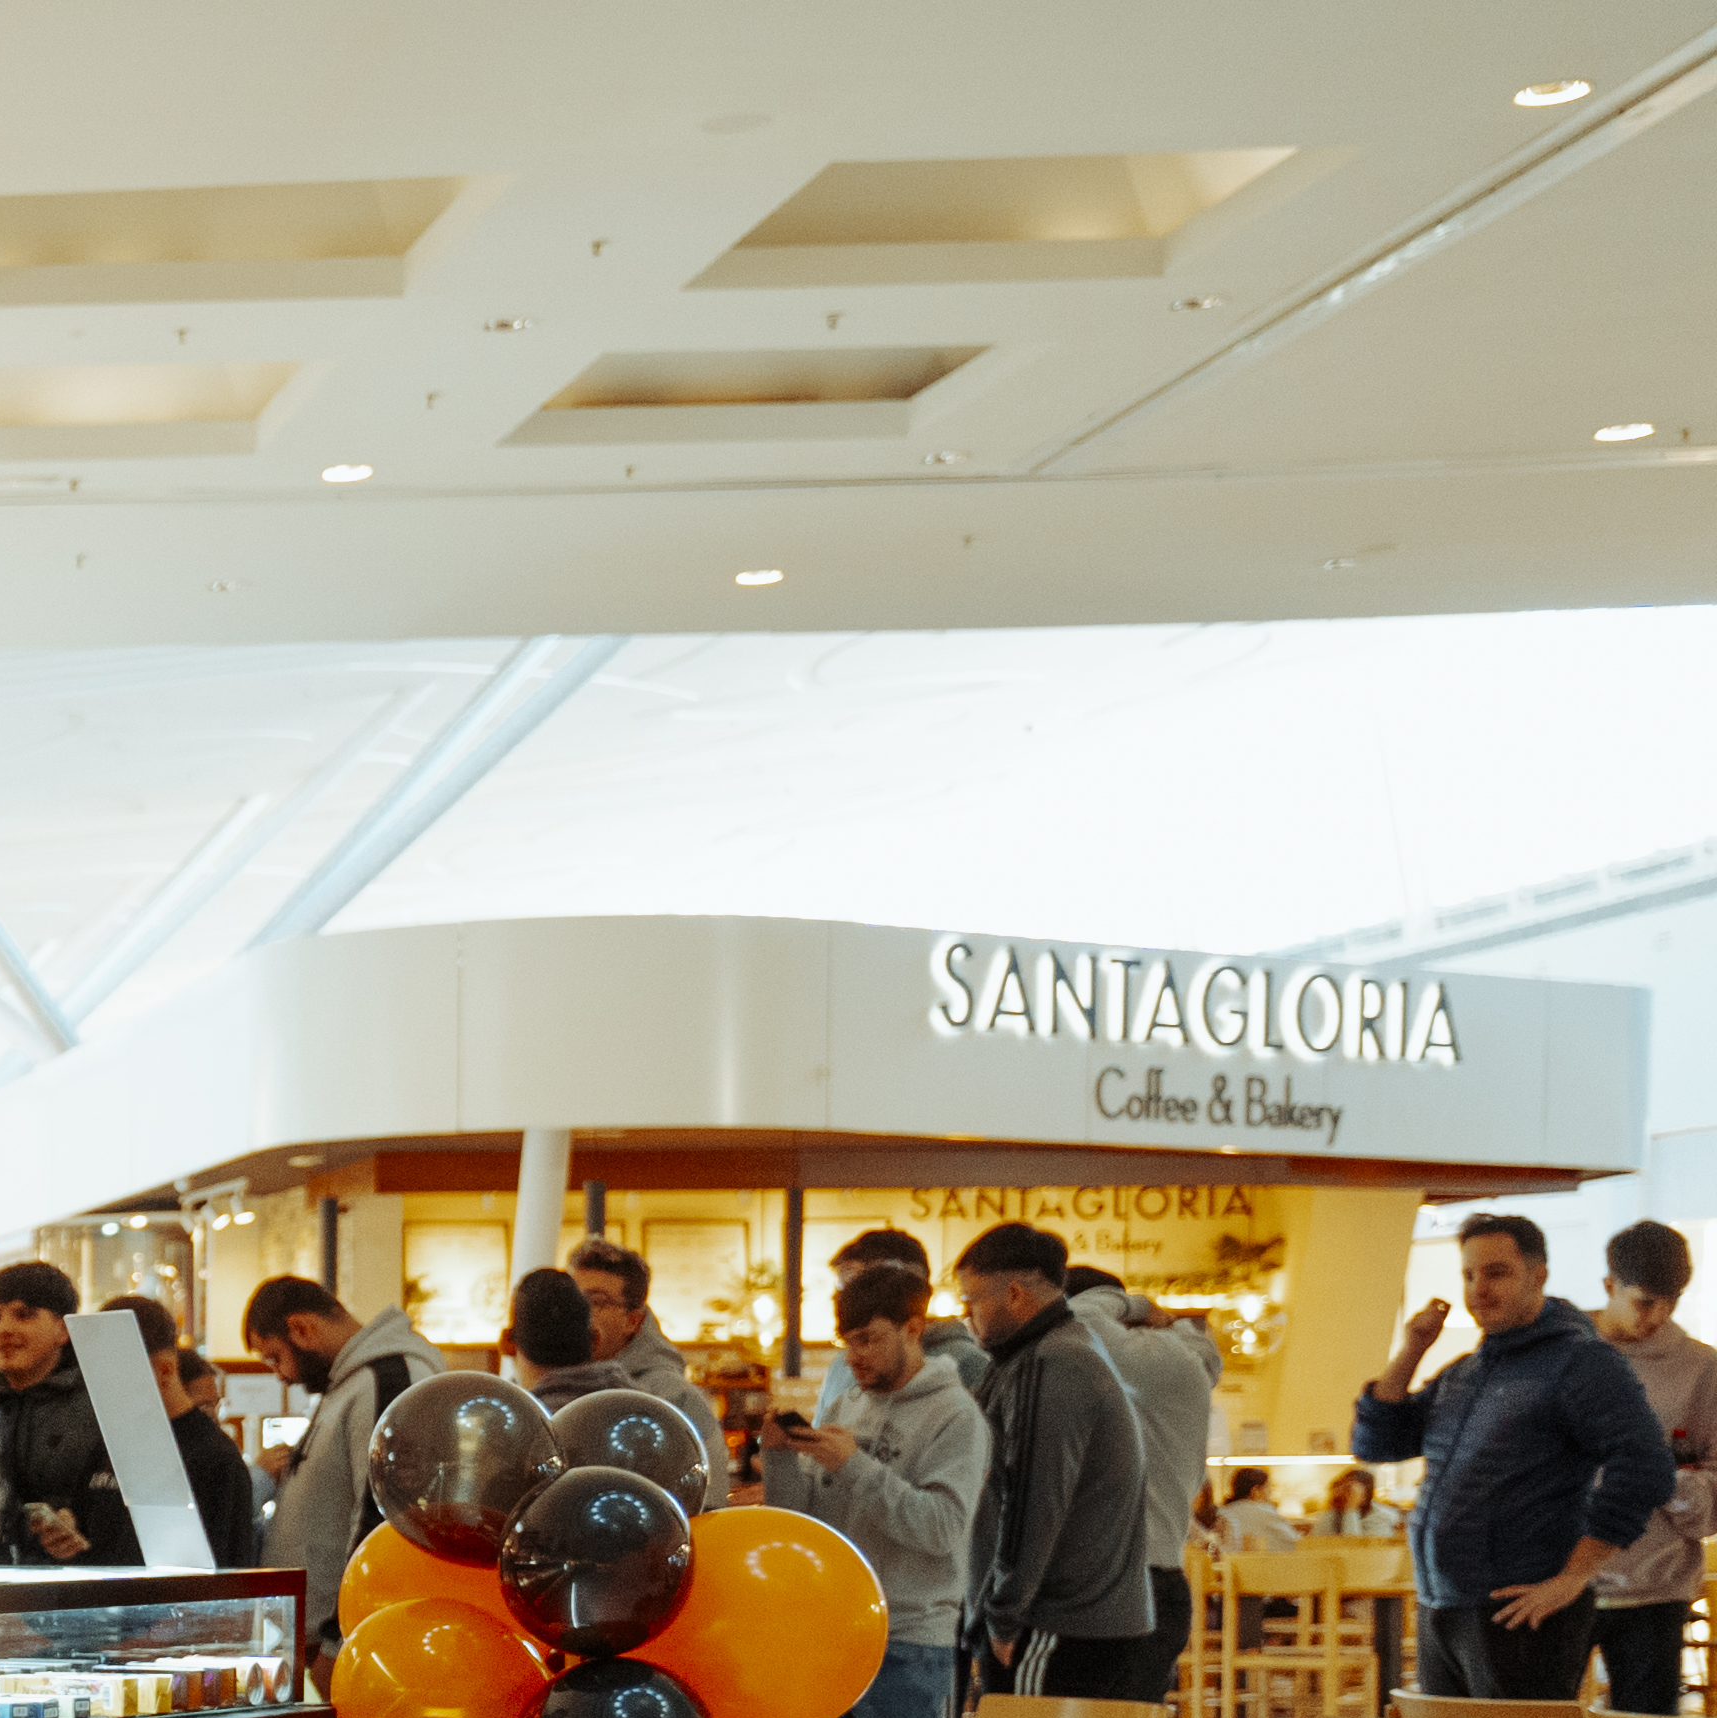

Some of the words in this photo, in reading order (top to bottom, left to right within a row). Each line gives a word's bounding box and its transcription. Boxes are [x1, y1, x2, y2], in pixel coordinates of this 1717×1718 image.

[933, 937, 1461, 1065] SANTAGLORIA
[1095, 1066, 1197, 1121] Coffee
[1209, 1073, 1233, 1124] &
[1245, 1076, 1342, 1146] Bakery
[910, 1186, 1254, 1222] SANTAGLORIA
